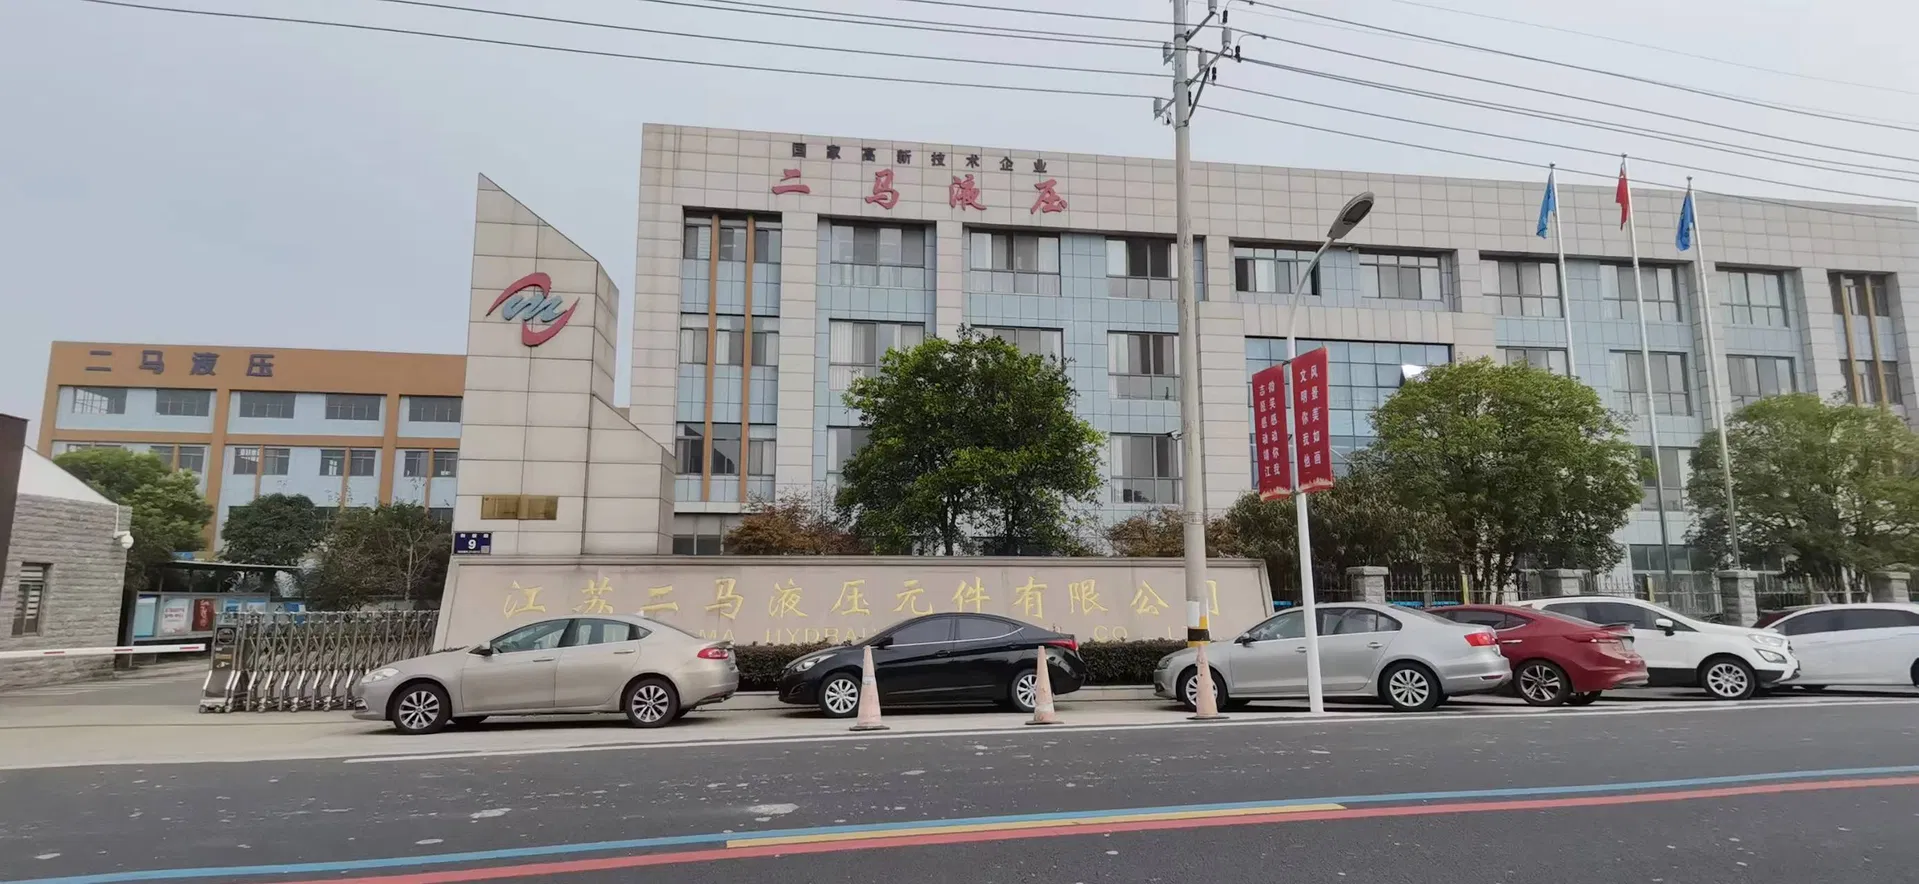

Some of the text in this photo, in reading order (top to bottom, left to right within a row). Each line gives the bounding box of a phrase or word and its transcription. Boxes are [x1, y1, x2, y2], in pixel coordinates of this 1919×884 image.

[792, 142, 1047, 174] 国家高新技术企业
[771, 168, 1068, 215] 二马液压
[85, 350, 275, 377] 二马液压
[1300, 369, 1311, 468] 文明你我他
[1310, 364, 1321, 466] 风景美如画
[468, 539, 476, 549] 9
